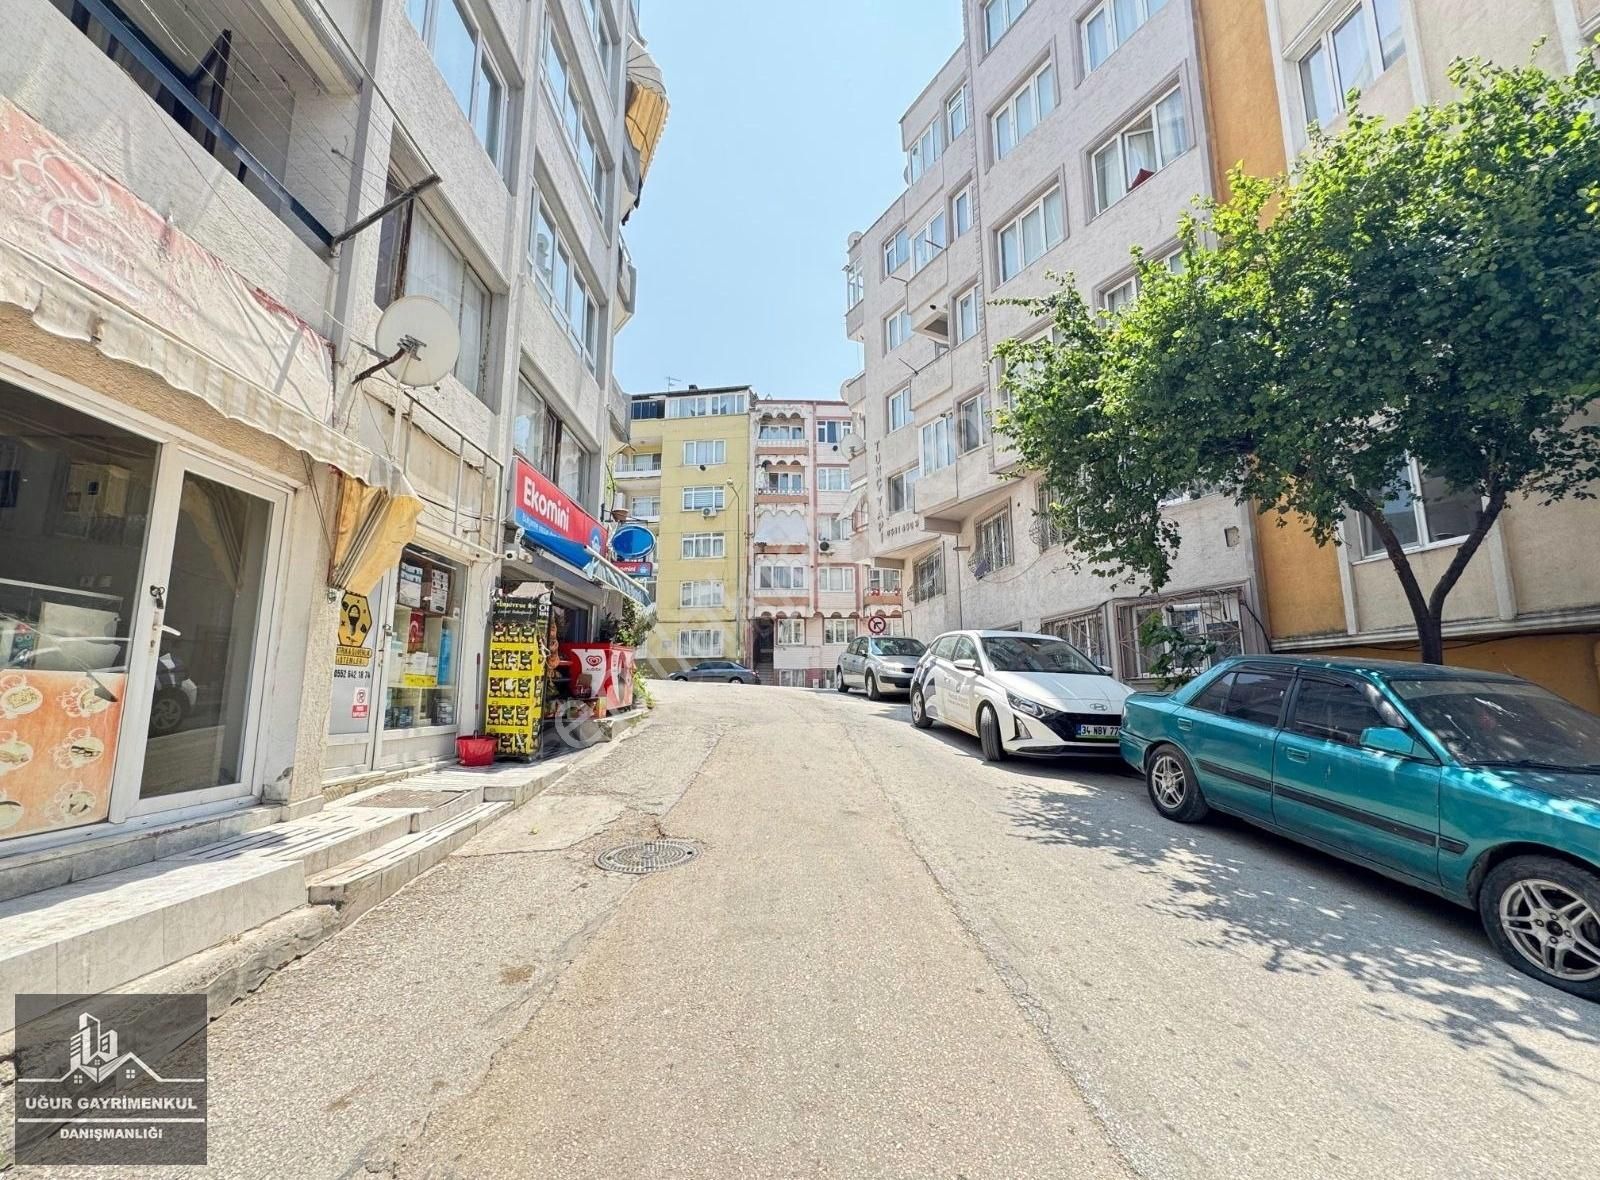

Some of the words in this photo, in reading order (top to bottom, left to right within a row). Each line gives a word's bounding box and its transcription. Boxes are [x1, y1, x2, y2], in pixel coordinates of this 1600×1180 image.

[523, 475, 570, 533] Ekomini
[1082, 726, 1090, 735] 34
[1110, 726, 1121, 736] 77
